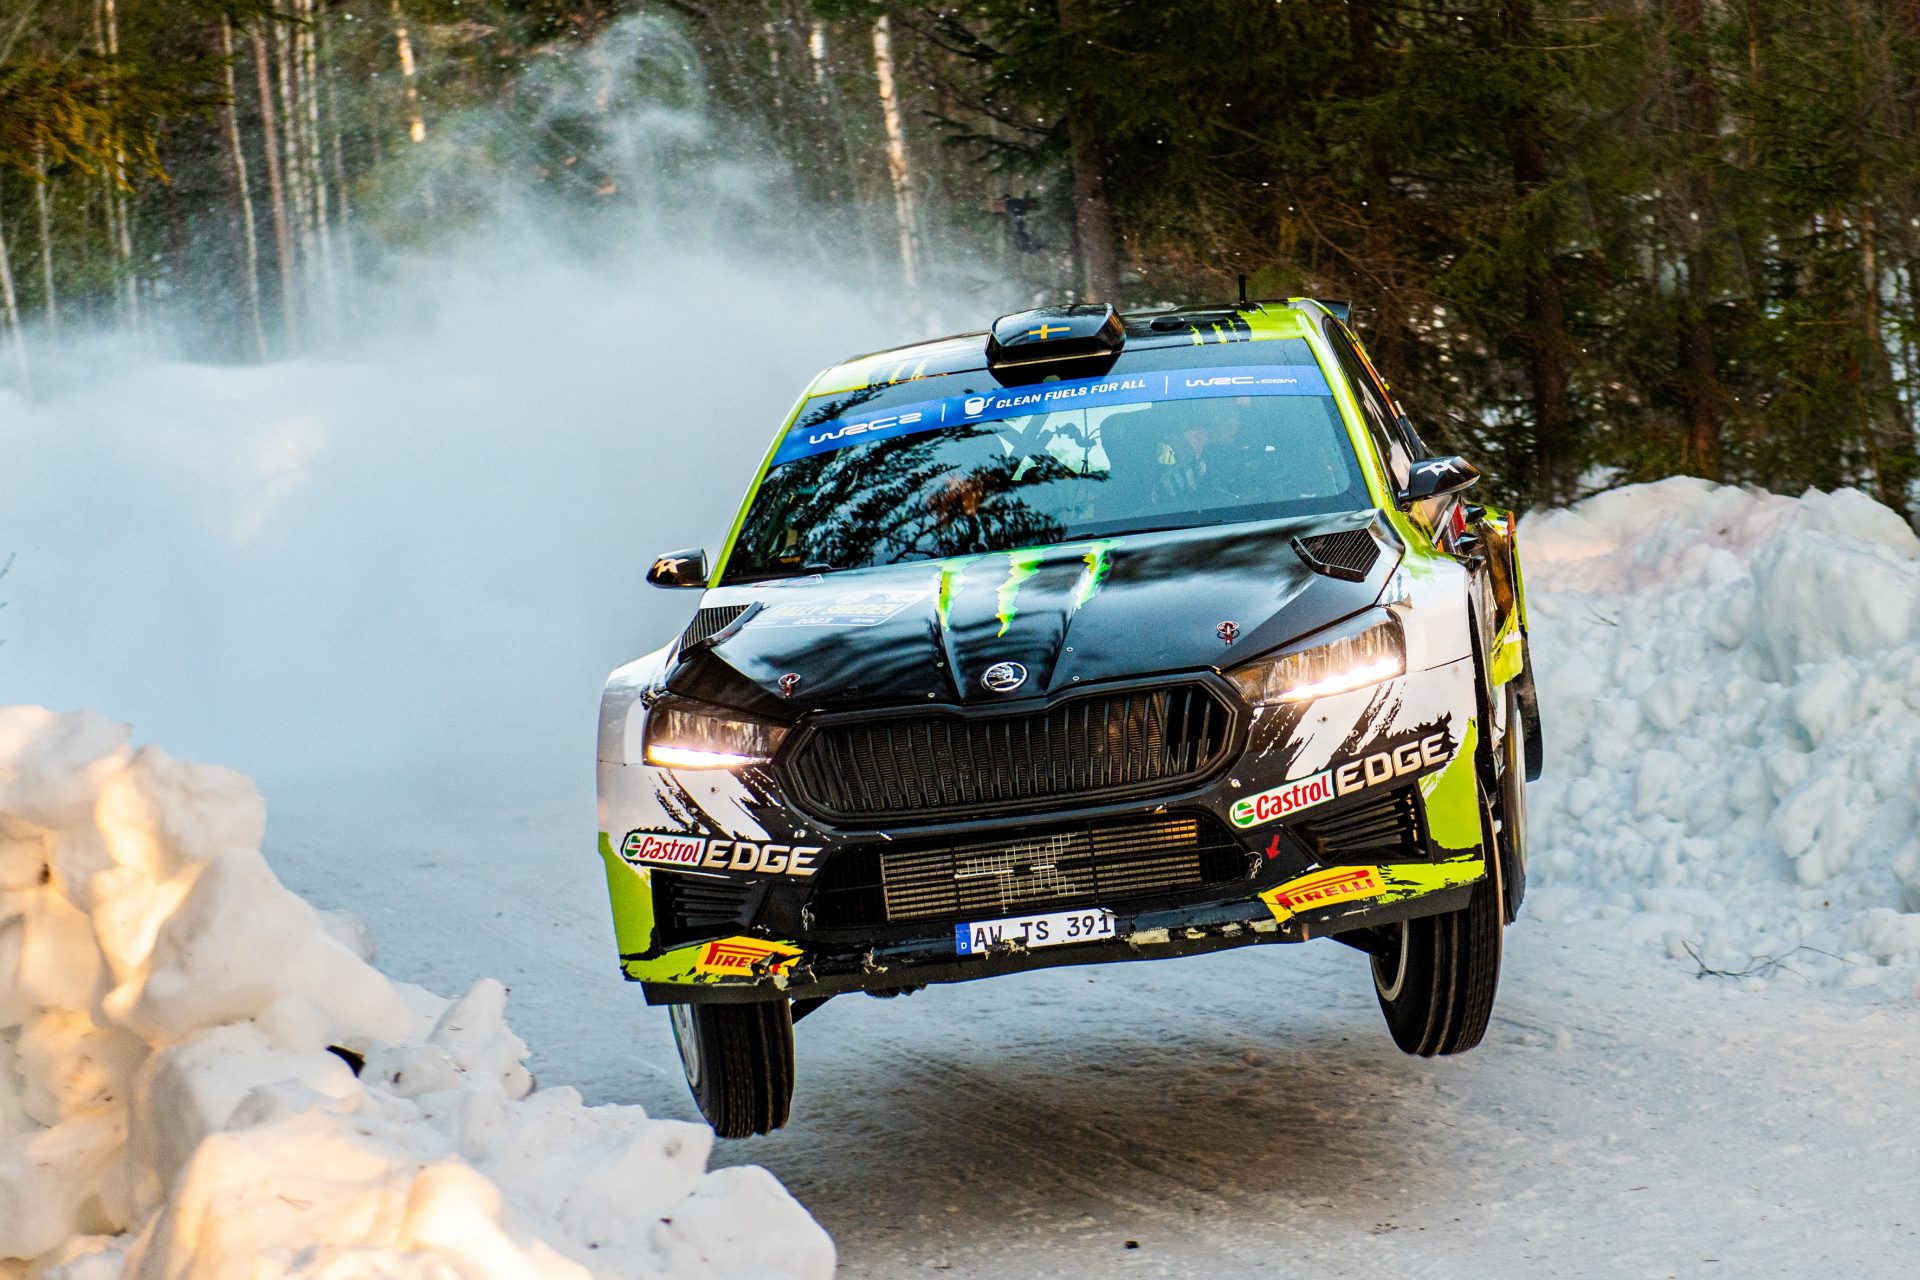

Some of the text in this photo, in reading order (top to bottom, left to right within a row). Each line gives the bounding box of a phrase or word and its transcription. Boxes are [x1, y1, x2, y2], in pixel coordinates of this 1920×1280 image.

[996, 379, 1146, 409] CLEAN FUELS FOR ALL
[809, 412, 922, 445] WRC2
[1255, 731, 1451, 821] Castrol EDGE
[639, 836, 824, 876] Castrol EDGE
[1274, 869, 1376, 910] PIRELLI
[973, 914, 1112, 948] AW TS 391
